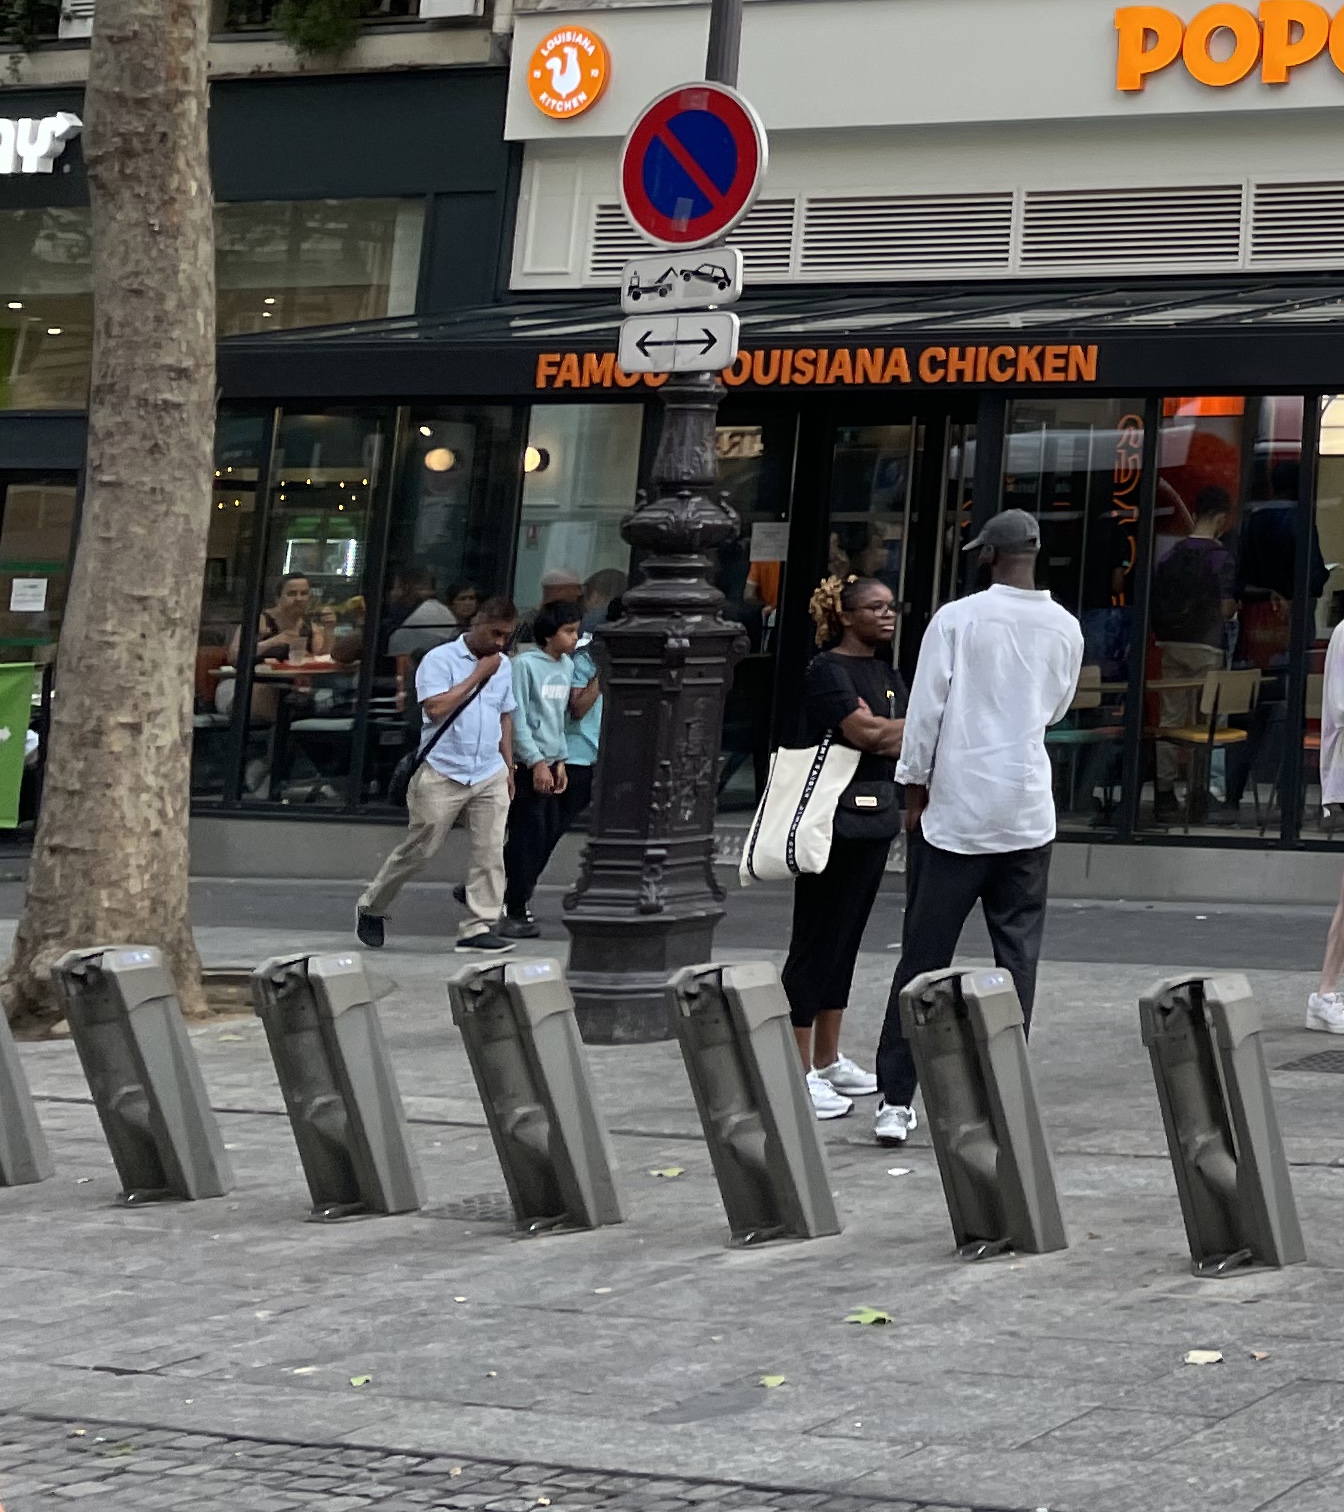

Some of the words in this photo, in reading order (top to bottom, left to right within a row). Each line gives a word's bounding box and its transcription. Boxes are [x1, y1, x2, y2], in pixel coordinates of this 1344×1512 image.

[540, 31, 596, 57] LOUISIANA
[539, 90, 588, 113] KITCHEN
[535, 352, 671, 389] FAM
[714, 346, 912, 387] OUISIANA
[918, 344, 1099, 384] CHICKEN
